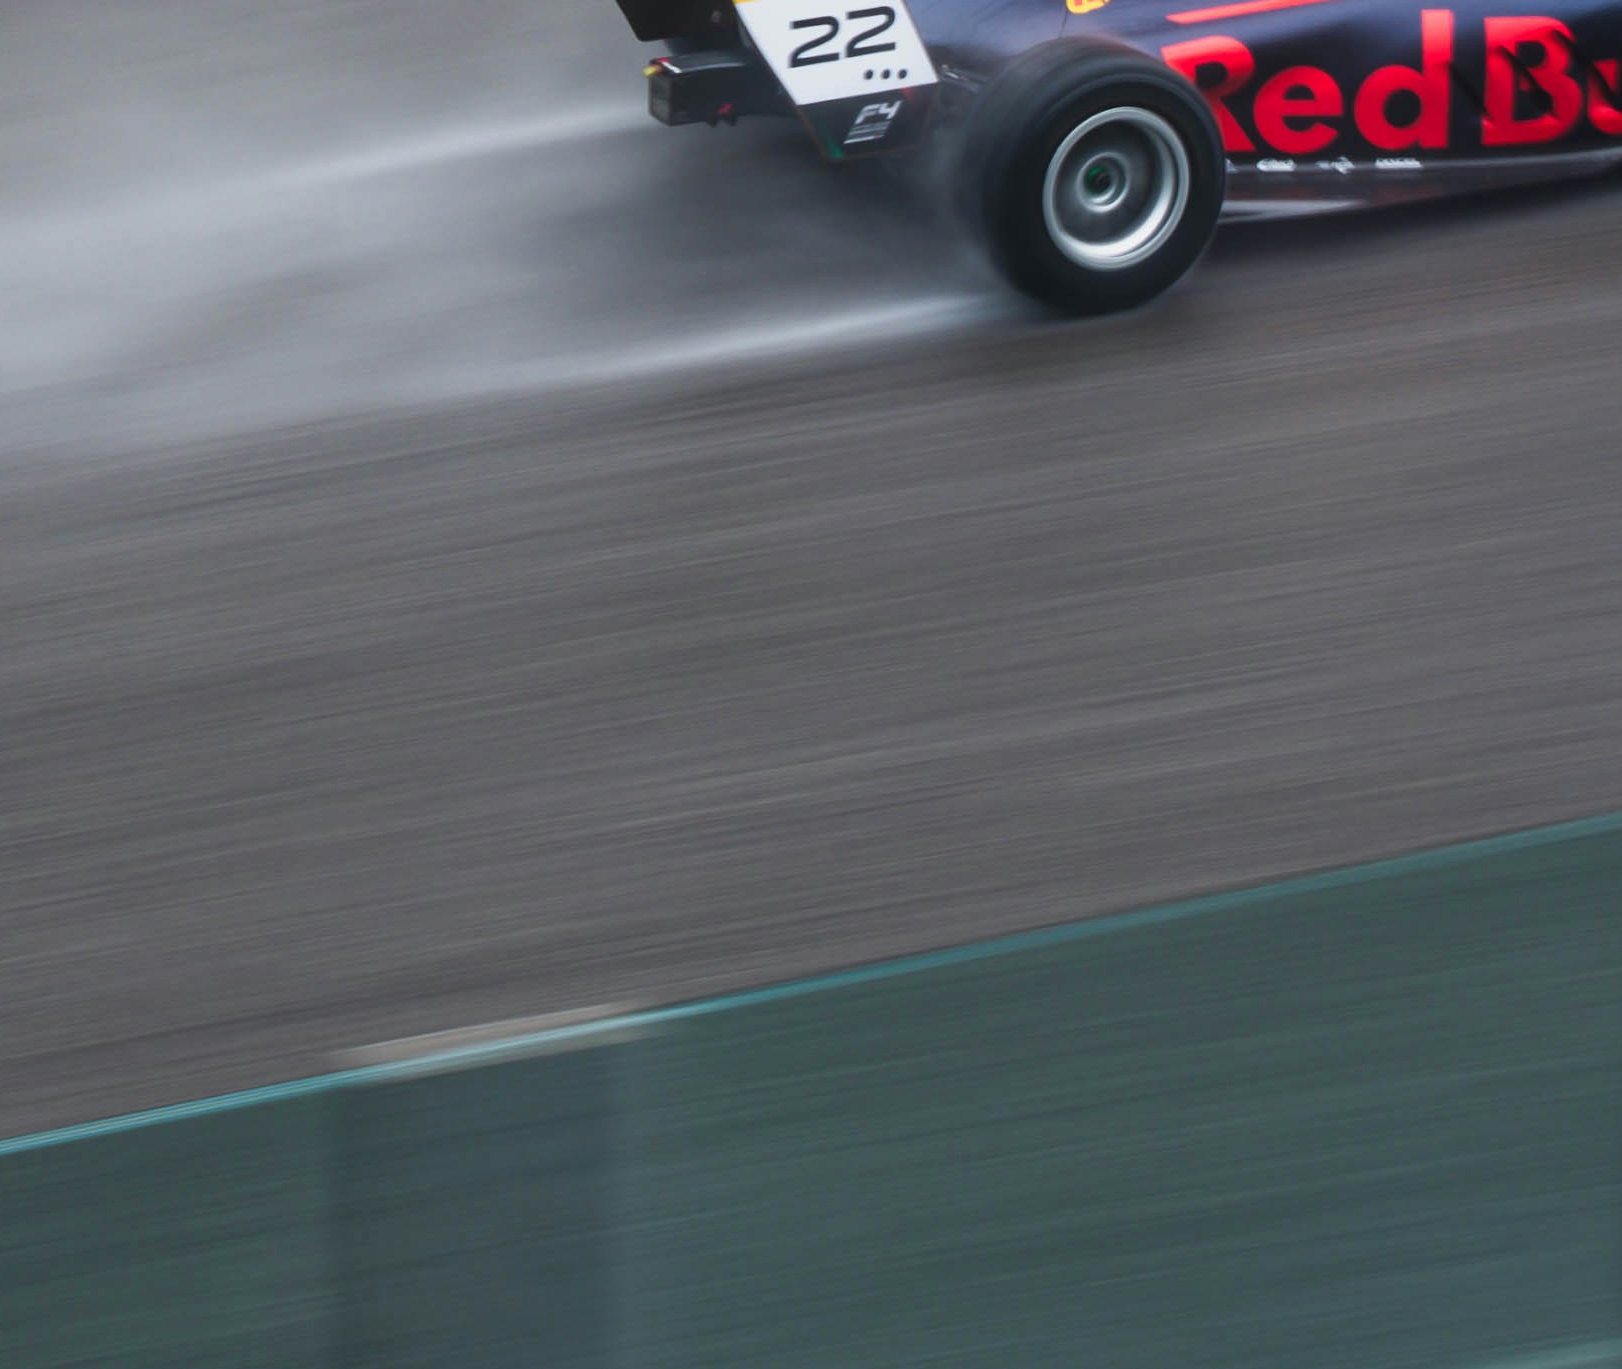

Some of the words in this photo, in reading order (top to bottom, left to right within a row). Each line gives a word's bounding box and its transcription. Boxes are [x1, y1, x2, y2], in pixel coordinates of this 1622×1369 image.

[789, 6, 895, 68] 22
[855, 100, 902, 125] F4
[1161, 9, 1454, 154] Red
